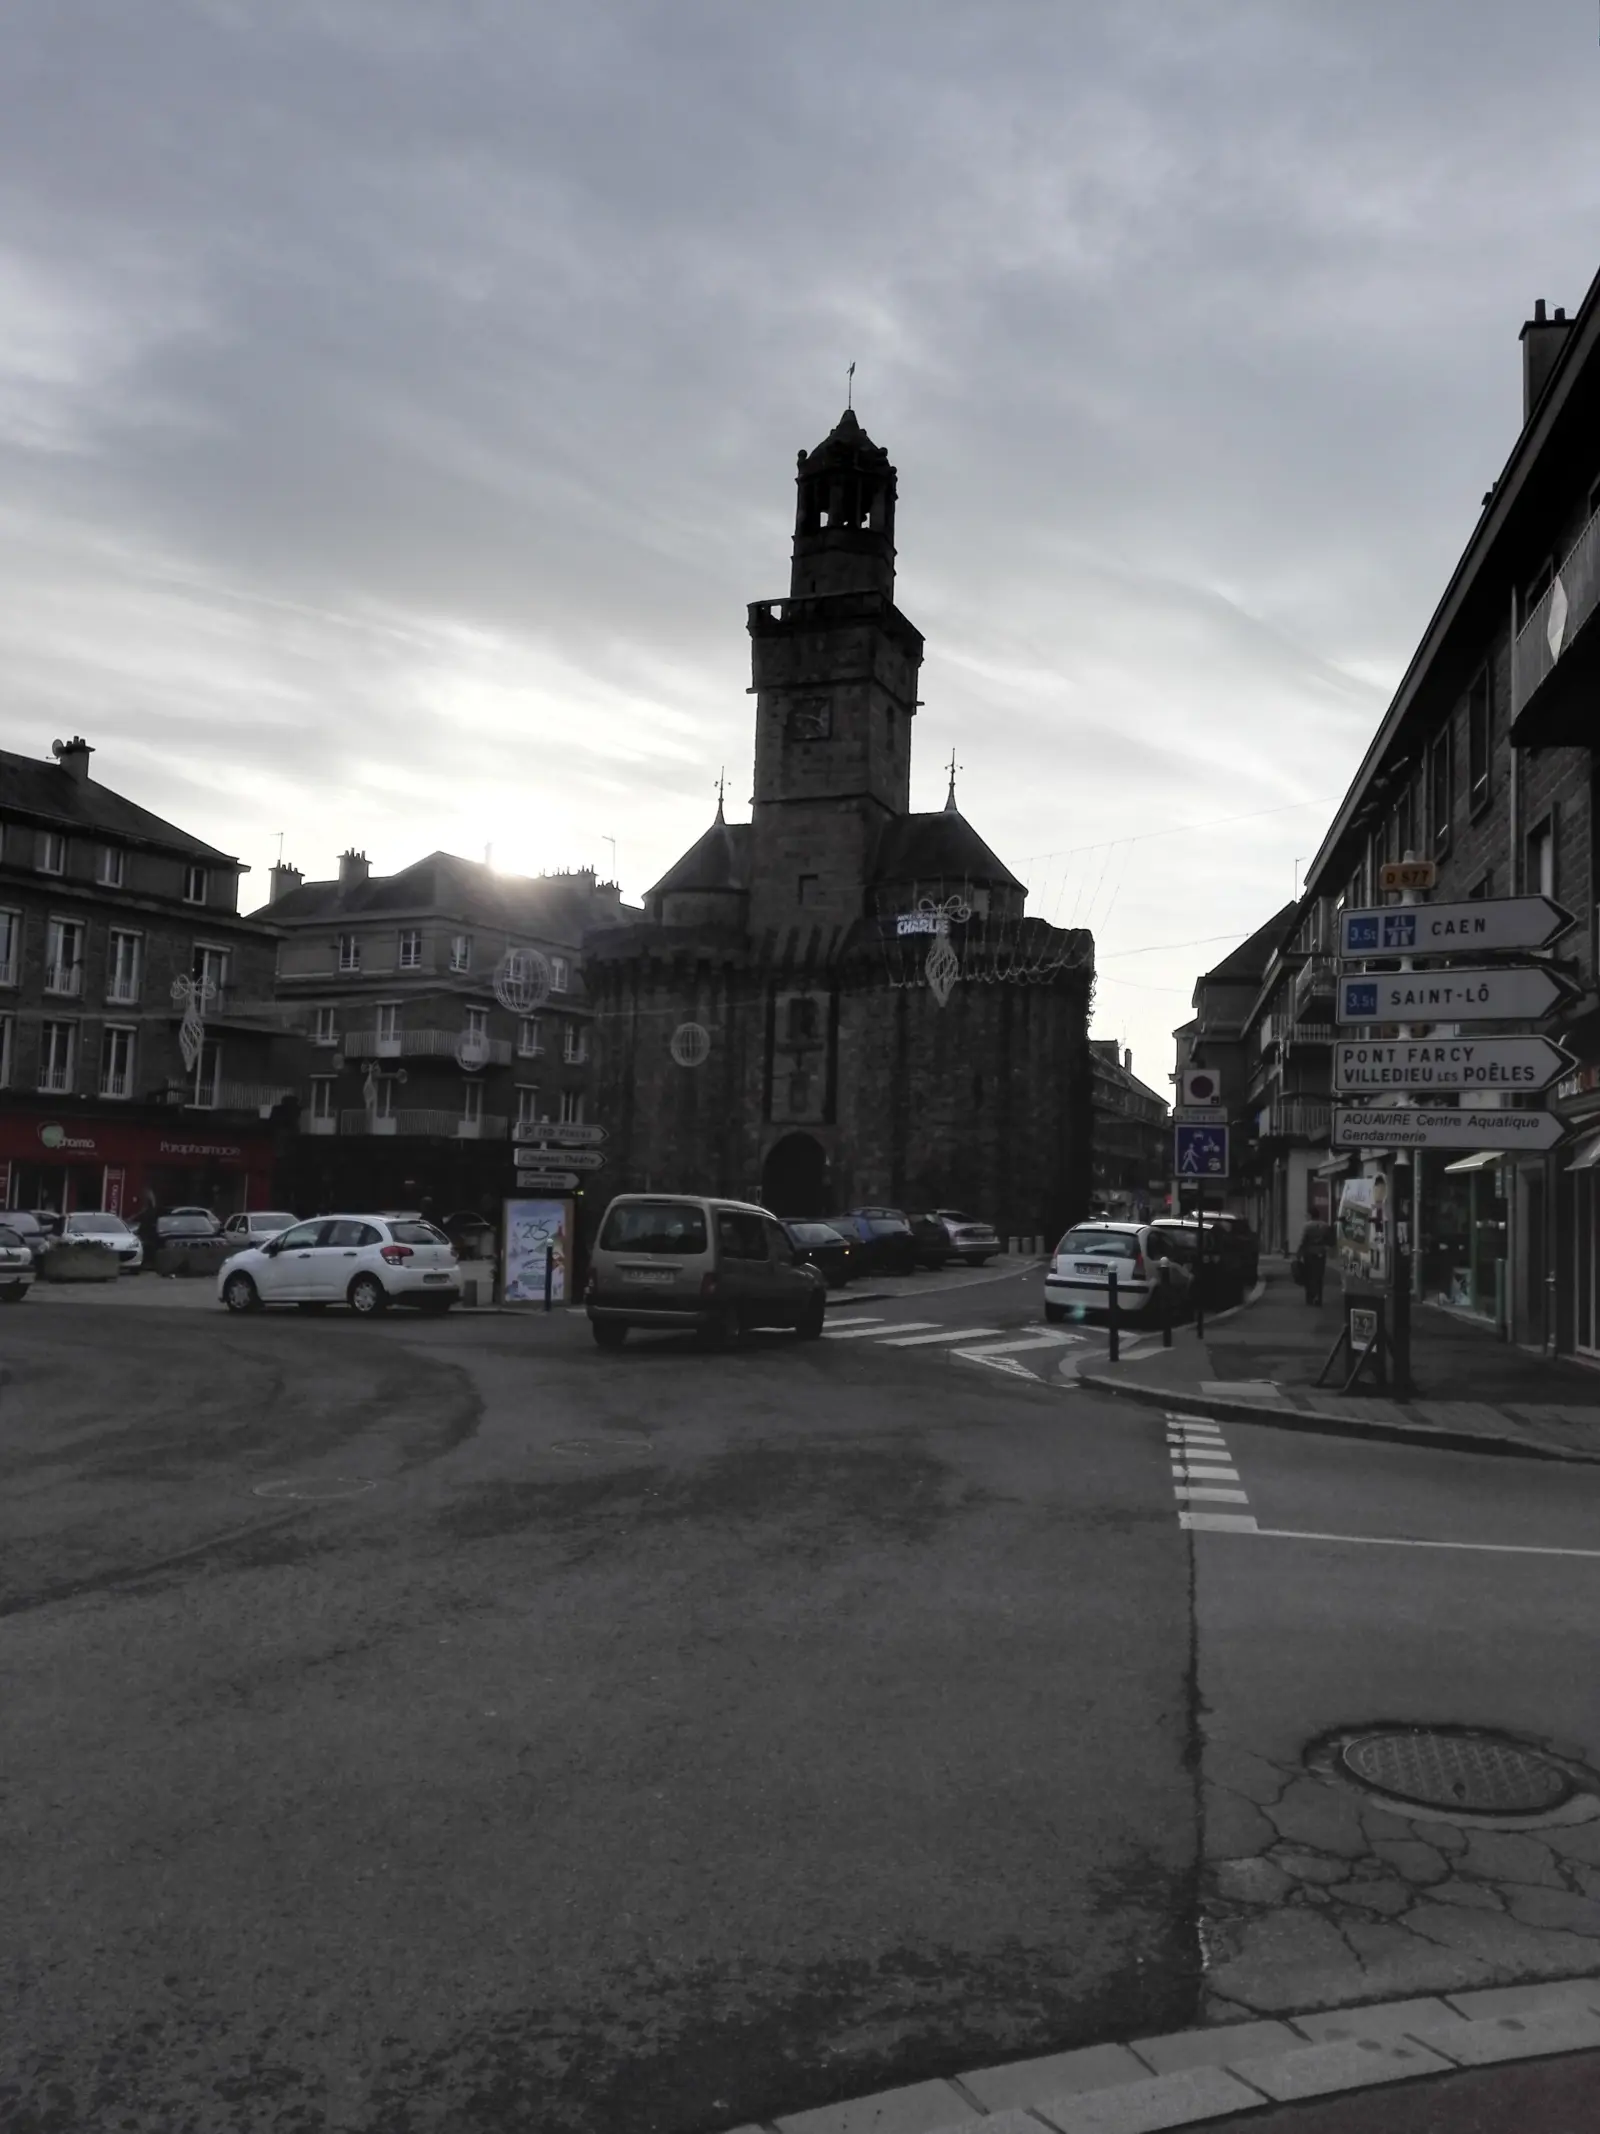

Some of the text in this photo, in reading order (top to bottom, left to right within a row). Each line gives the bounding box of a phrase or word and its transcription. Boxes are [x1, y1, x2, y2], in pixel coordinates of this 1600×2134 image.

[1386, 869, 1429, 885] D 577
[1431, 918, 1486, 936] CAEN
[1391, 984, 1490, 1006] SAINT-LÔ
[1343, 1047, 1475, 1064] PONT FARCY
[1344, 1063, 1535, 1083] VILLEDIEU LES POÊLES
[1342, 1113, 1540, 1130] AQUAVIRE Centre Aquatique
[1342, 1129, 1427, 1143] Gendarmerie
